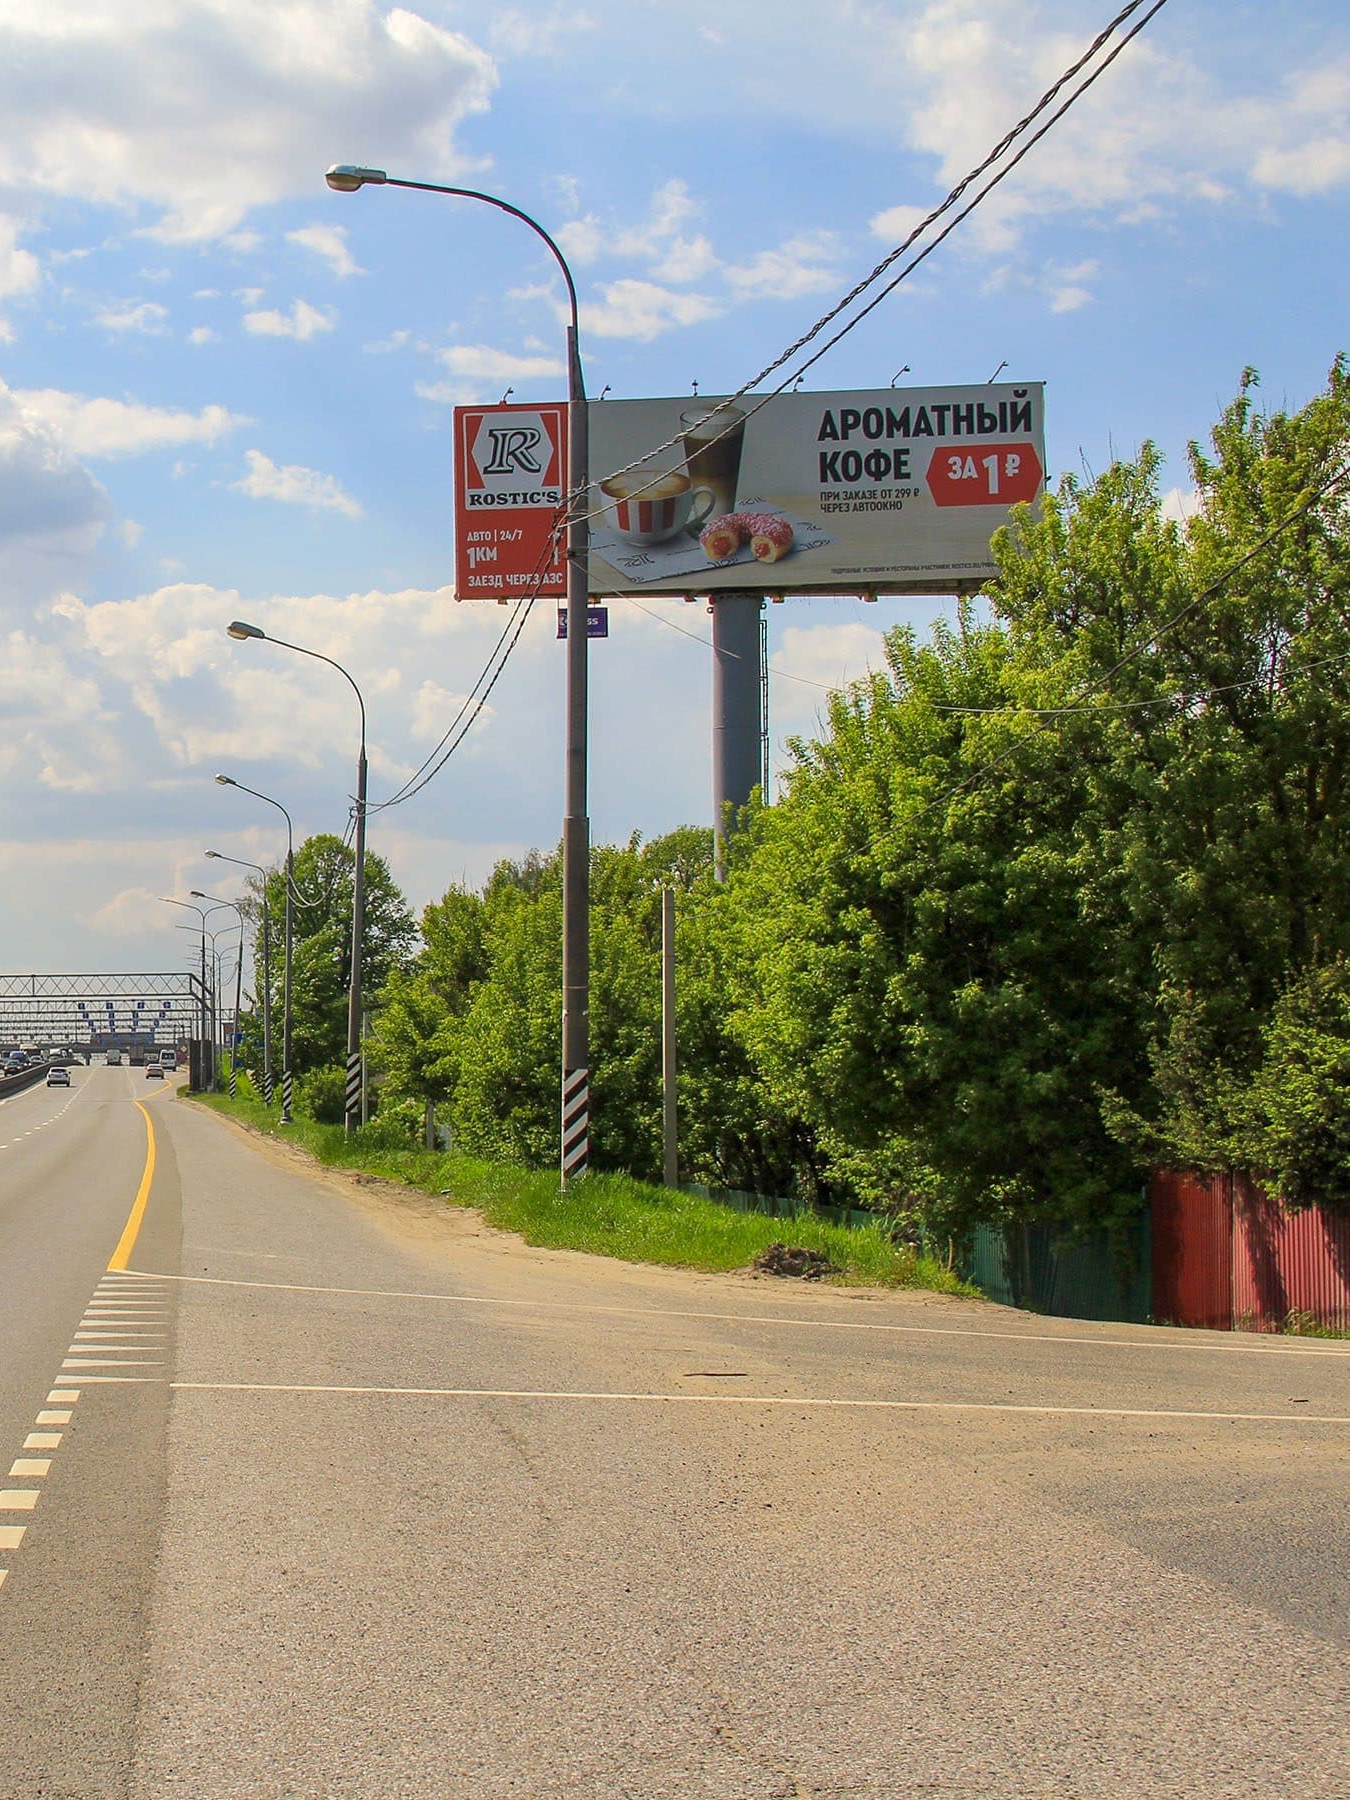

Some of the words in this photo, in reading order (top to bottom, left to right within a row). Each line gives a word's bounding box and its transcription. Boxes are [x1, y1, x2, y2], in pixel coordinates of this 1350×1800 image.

[817, 389, 1032, 442] АРОМАТНЫЙ
[483, 427, 542, 475] R
[819, 448, 911, 483] КОФЕ
[947, 456, 979, 480] ЗА
[469, 491, 560, 506] ROSTIC'S
[820, 491, 840, 502] ПРИ
[842, 489, 878, 501] ЗАКАЗЕ
[881, 488, 893, 499] ОТ
[895, 488, 912, 499] 299
[820, 502, 850, 514] ЧЕРЕЗ
[852, 501, 903, 512] АВТООКНО
[466, 531, 492, 542] АВТО
[500, 529, 523, 541] 24/7
[468, 575, 503, 588] ЗАЕЗД
[506, 573, 540, 586] ЧЕРЕЗ
[542, 572, 563, 584] АЗС
